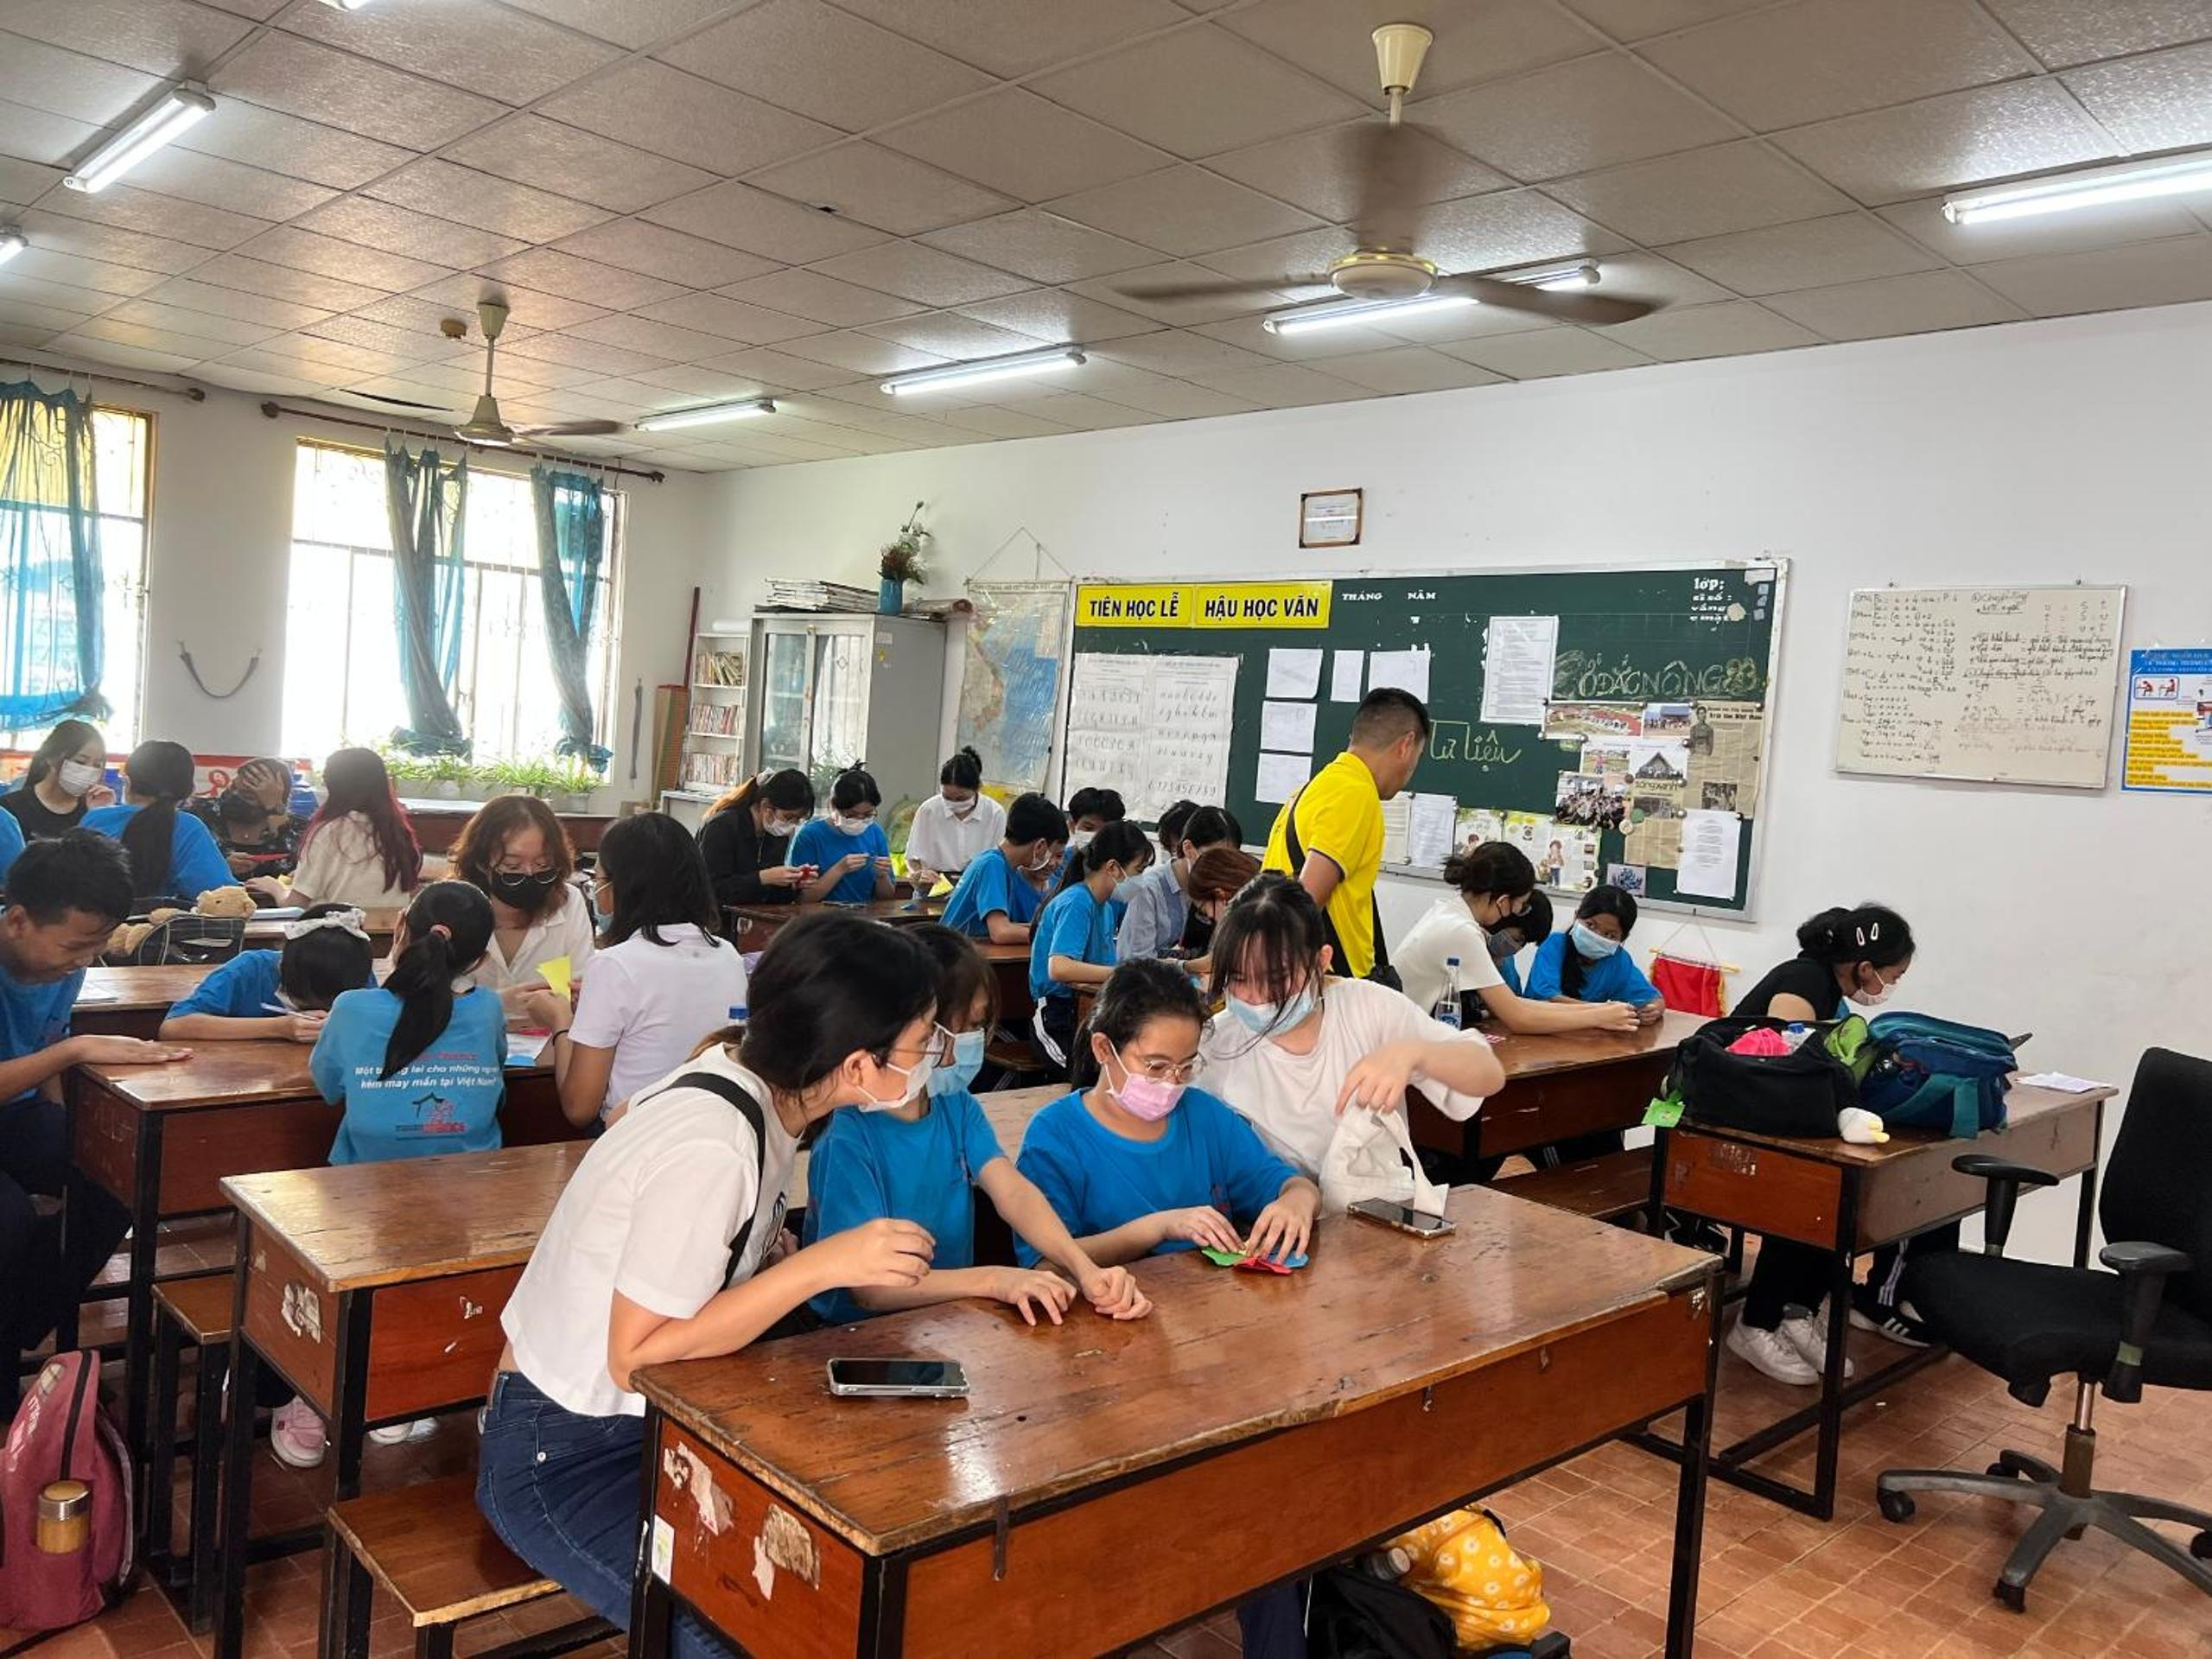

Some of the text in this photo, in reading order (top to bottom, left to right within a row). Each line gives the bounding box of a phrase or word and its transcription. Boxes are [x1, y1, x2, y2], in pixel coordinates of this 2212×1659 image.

[1342, 589, 1436, 601] THÁNG NĂM
[1126, 600, 1155, 620] HỌC
[1160, 591, 1179, 617] LỄ
[1205, 594, 1319, 621] HẬU HỌC VĂN
[427, 1065, 446, 1073] cho
[385, 1080, 409, 1089] may
